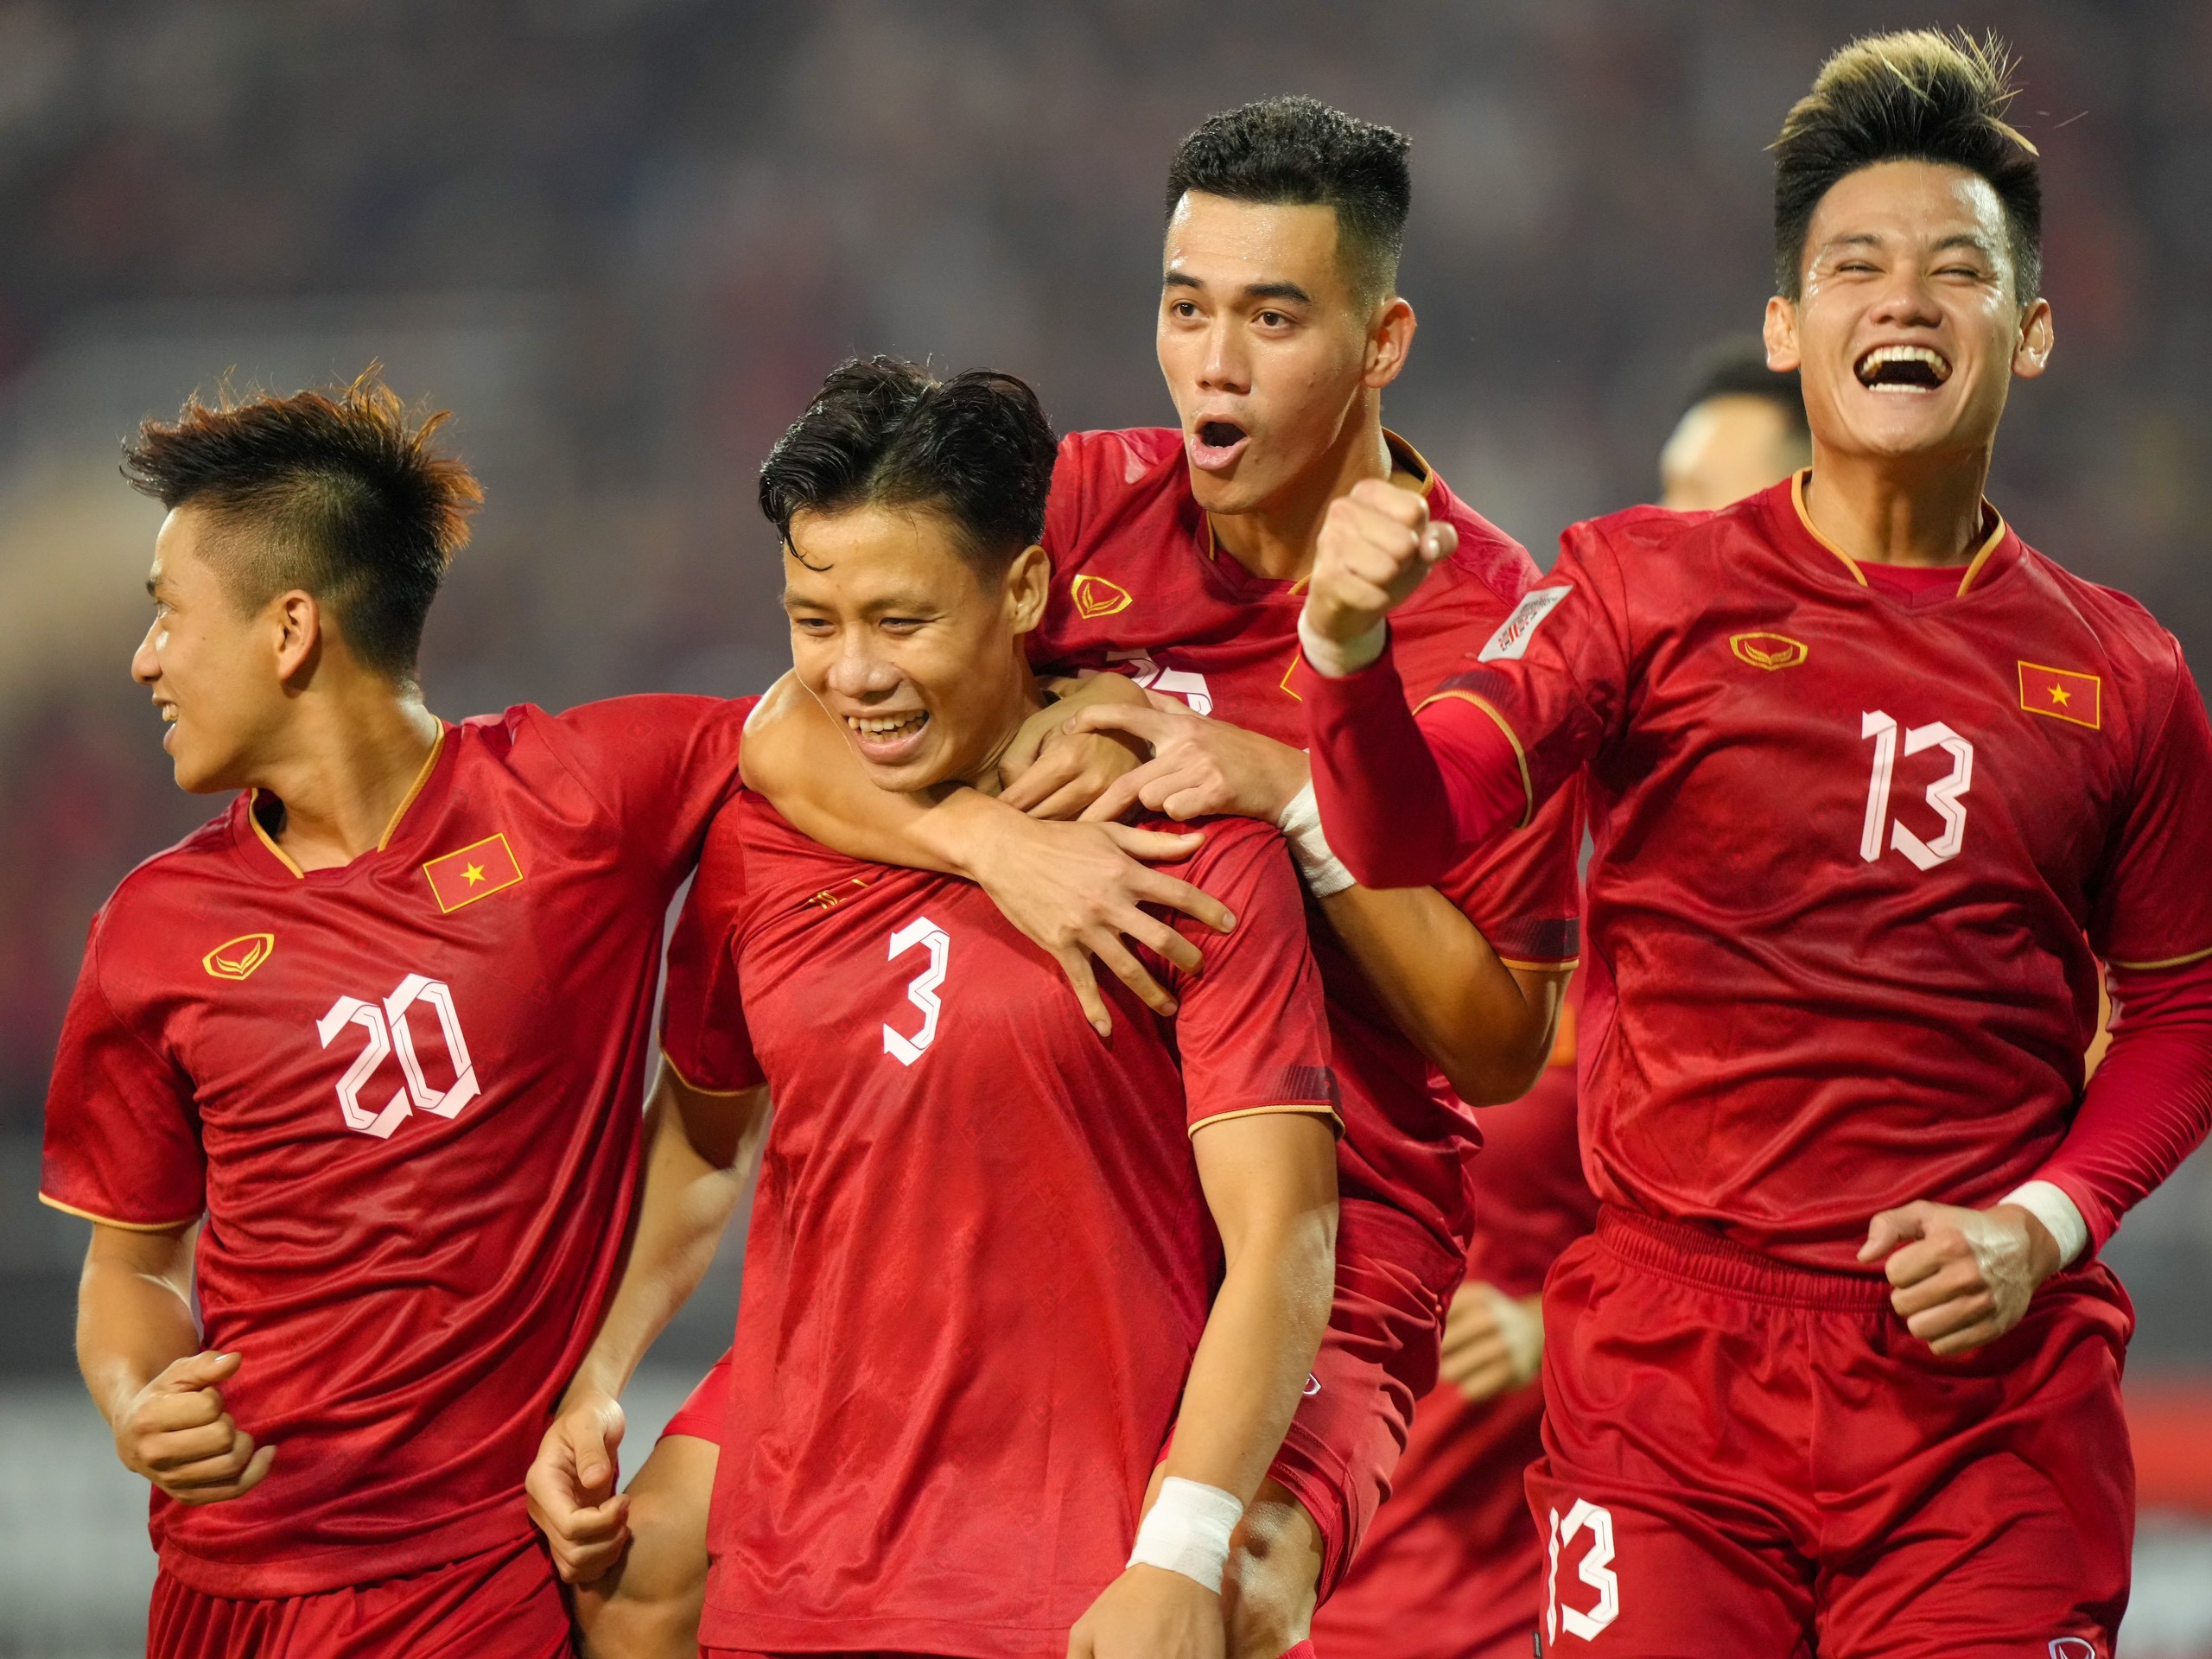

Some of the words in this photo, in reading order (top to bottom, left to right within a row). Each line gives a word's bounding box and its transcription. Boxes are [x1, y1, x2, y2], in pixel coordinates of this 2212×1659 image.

[1859, 709, 1974, 872] 13
[315, 973, 481, 1140] 20
[883, 916, 950, 1066] 3
[1546, 1497, 1619, 1647] 13
